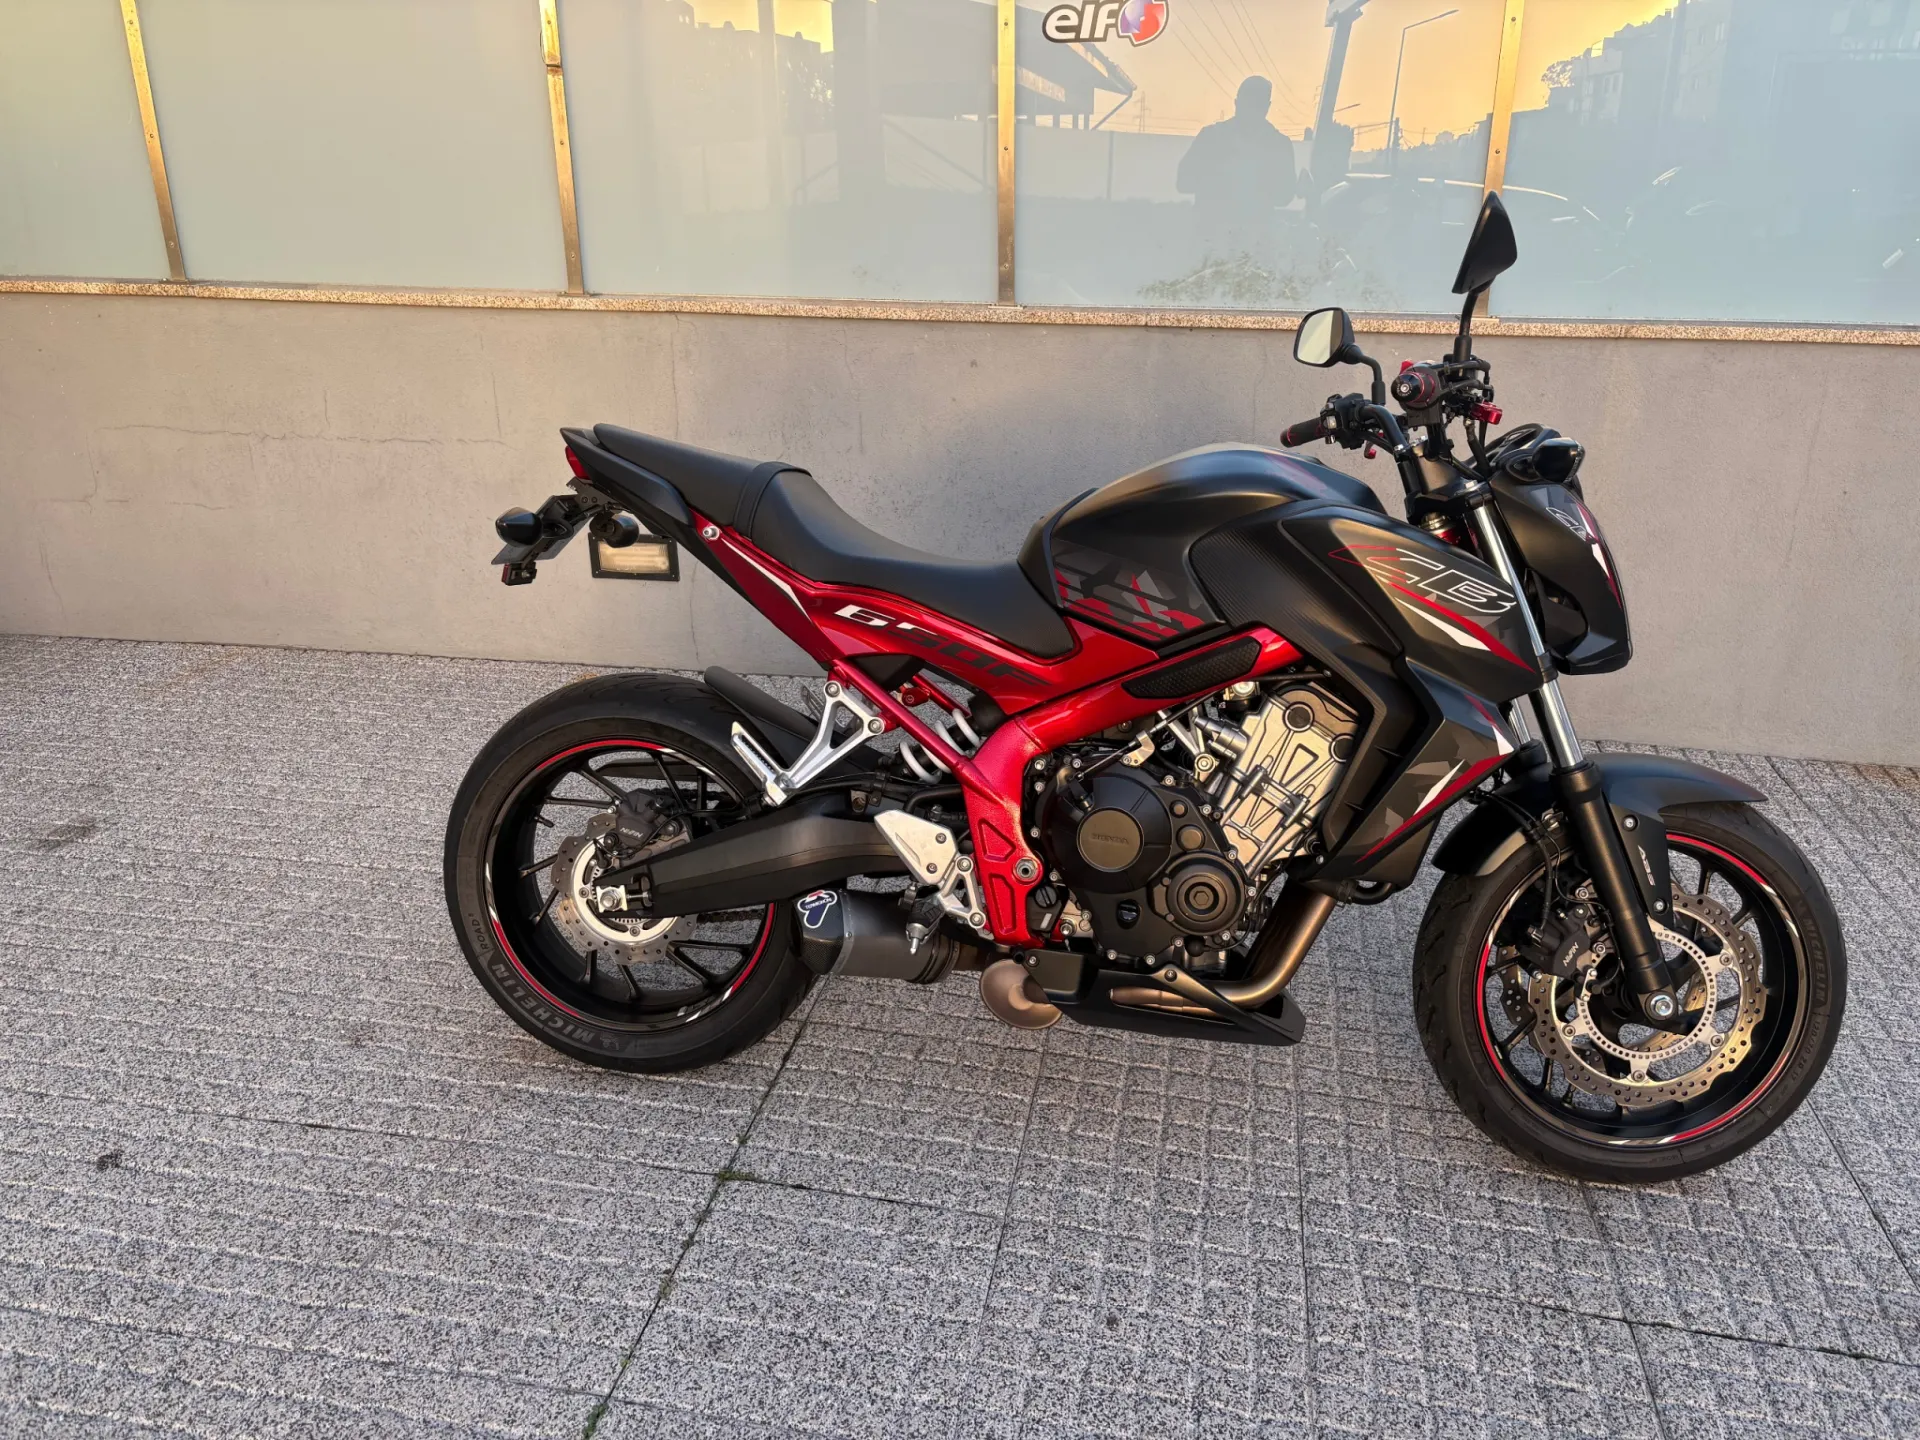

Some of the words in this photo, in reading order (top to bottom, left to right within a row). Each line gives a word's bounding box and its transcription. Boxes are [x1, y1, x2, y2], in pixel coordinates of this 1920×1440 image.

[1044, 2, 1119, 41] elf
[1328, 545, 1517, 613] CB
[1092, 833, 1129, 845] HONDA
[1638, 845, 1655, 886] ABS
[471, 918, 490, 950] ROAD
[1803, 916, 1826, 1002] MICHELIN
[492, 963, 596, 1043] MICHELIN
